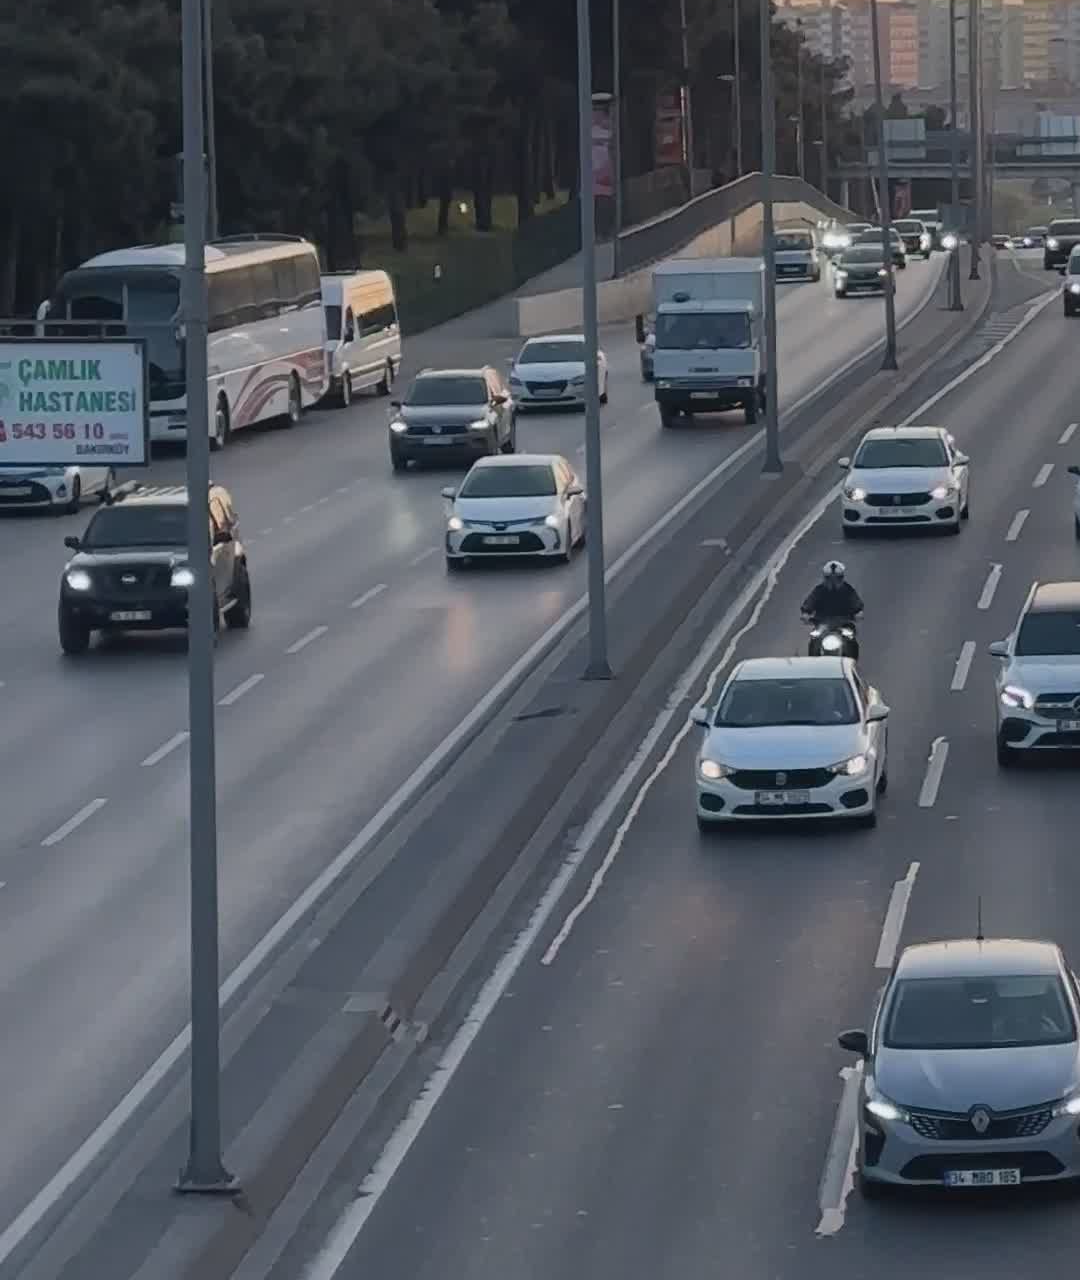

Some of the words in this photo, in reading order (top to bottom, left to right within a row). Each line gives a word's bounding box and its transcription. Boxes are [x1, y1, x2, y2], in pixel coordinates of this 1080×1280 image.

[18, 358, 102, 387] ÇAMLIK
[19, 387, 136, 413] HASTANESİ
[12, 423, 46, 439] 543
[52, 423, 75, 439] 56
[84, 423, 104, 439] 10
